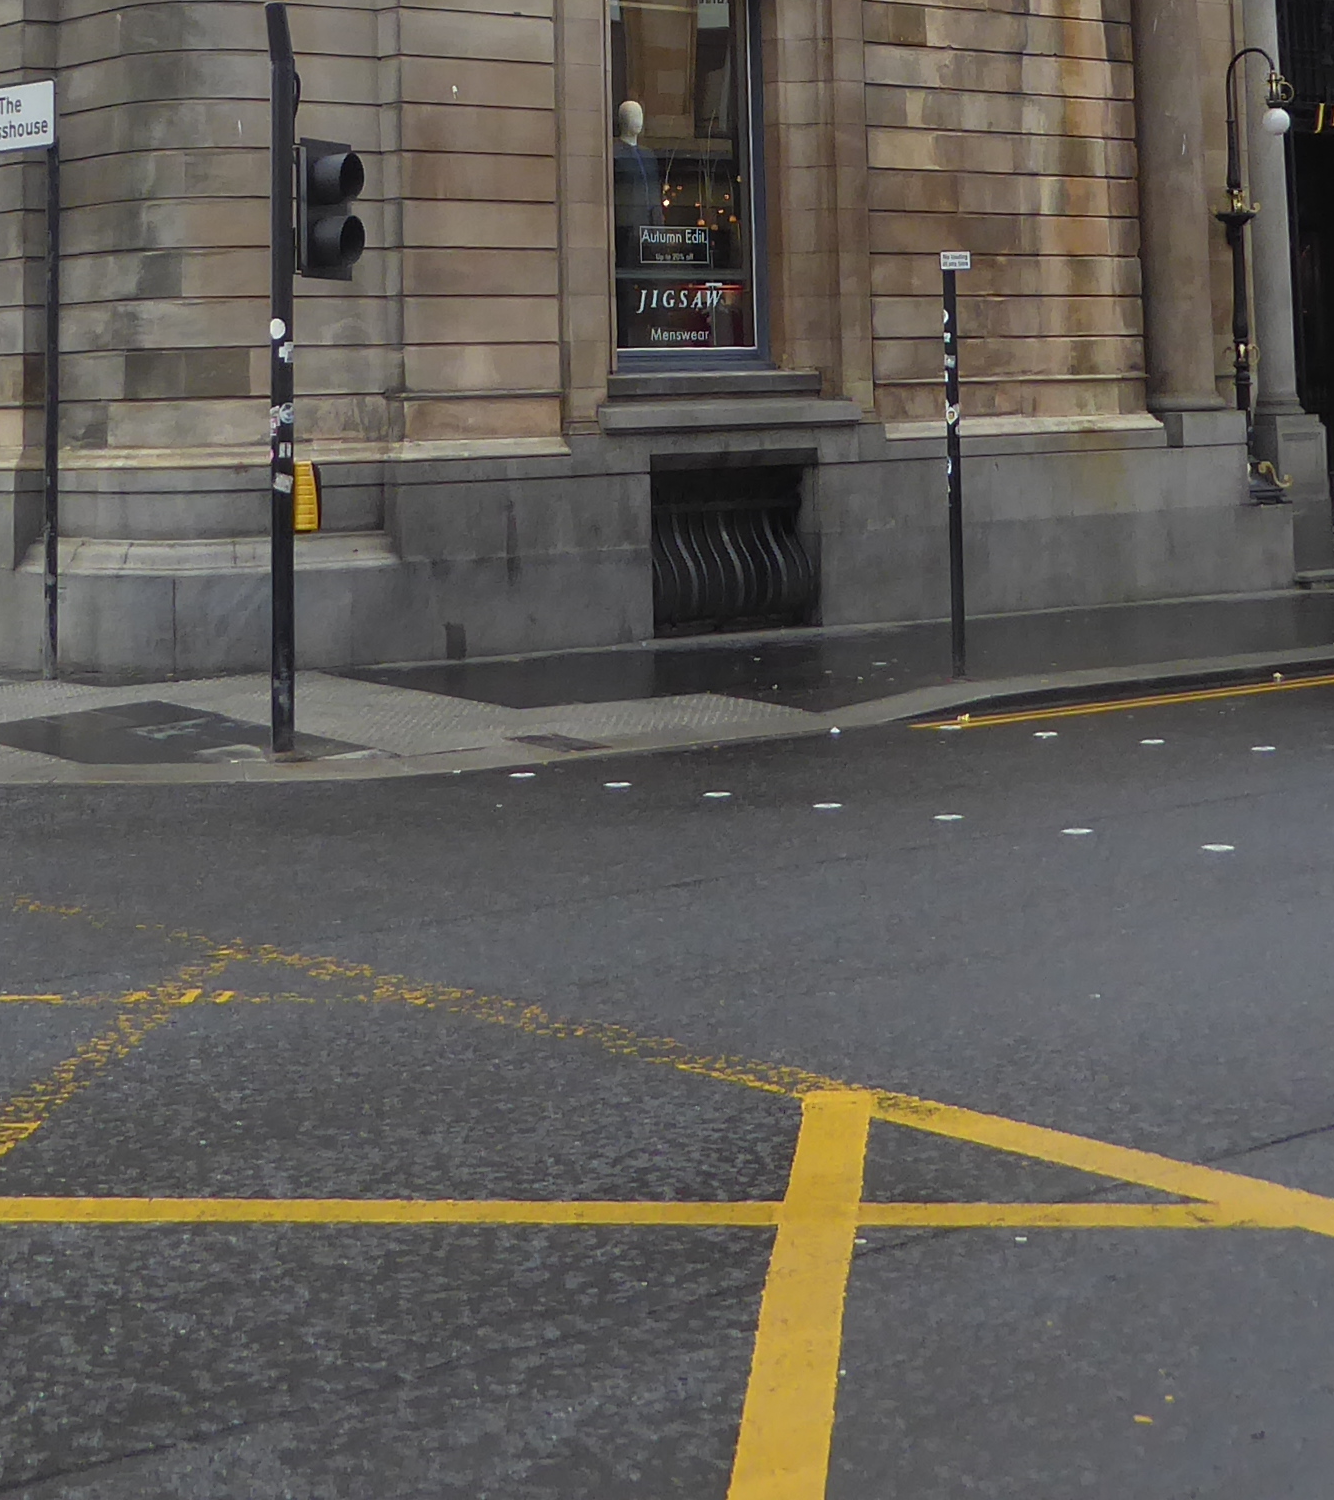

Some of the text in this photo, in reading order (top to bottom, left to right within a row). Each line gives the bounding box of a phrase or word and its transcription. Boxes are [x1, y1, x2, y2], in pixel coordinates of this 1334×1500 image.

[642, 229, 682, 244] Autumn
[635, 289, 723, 314] JIGSAW
[650, 327, 709, 341] Menswear
